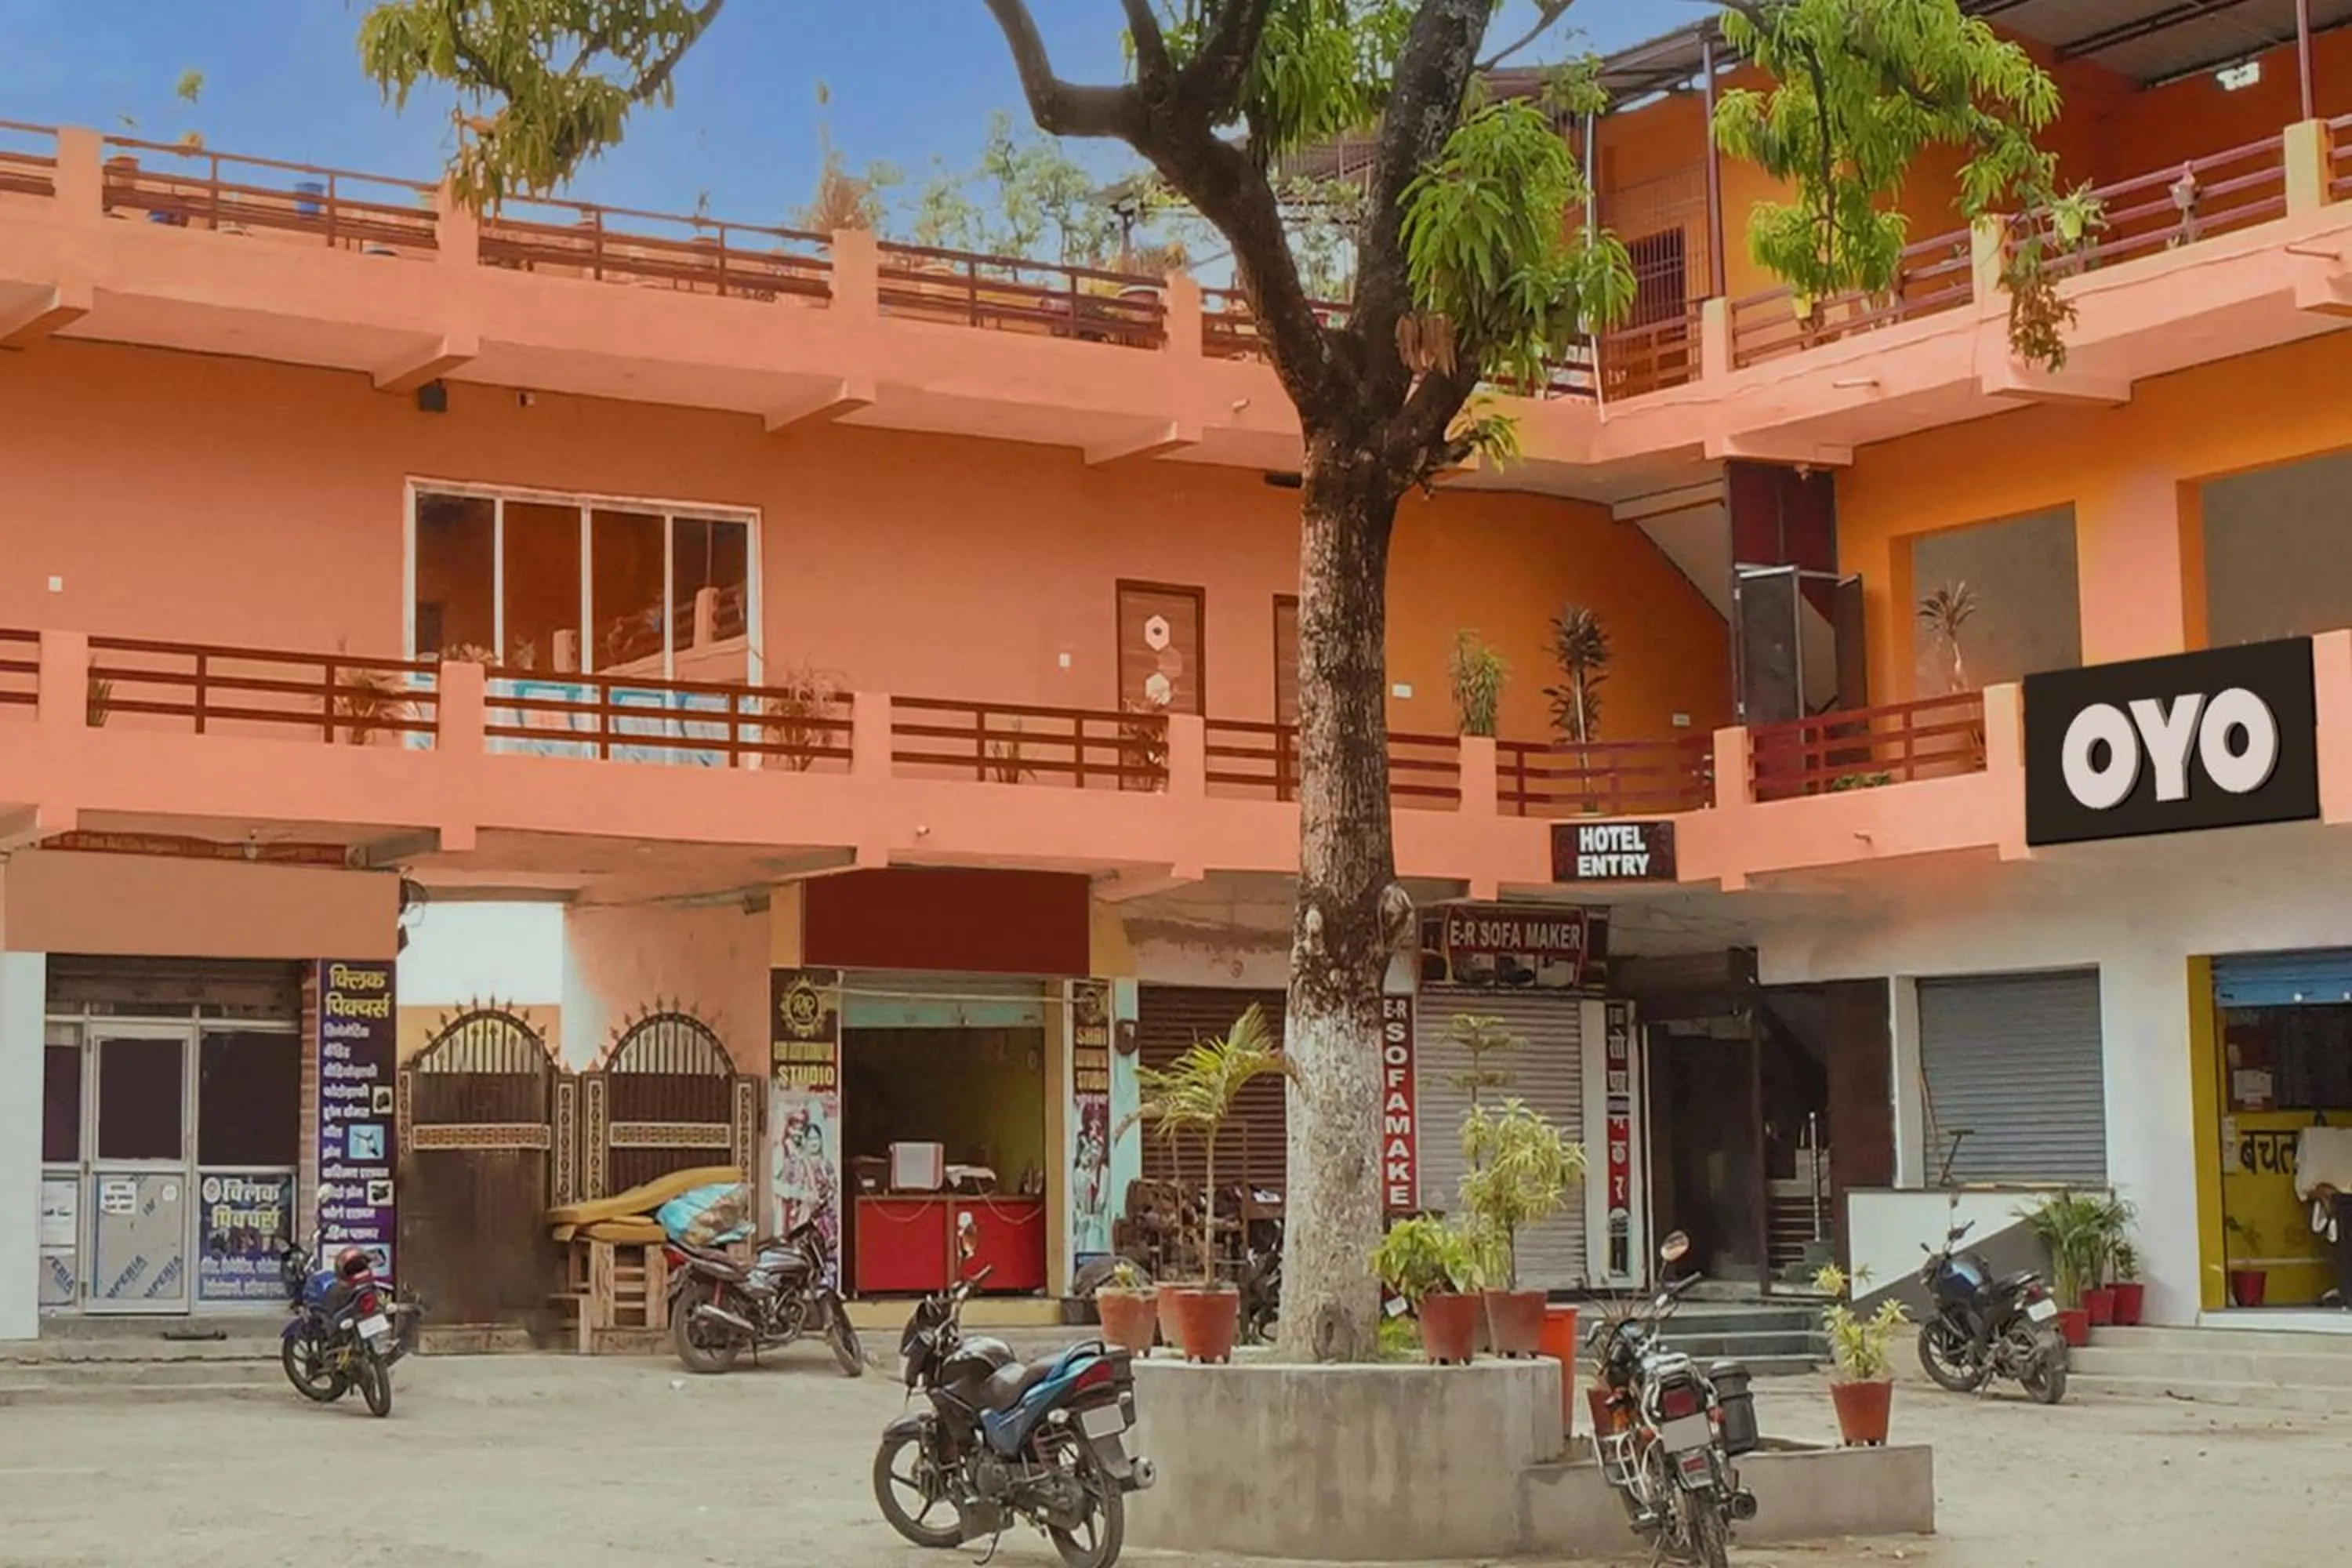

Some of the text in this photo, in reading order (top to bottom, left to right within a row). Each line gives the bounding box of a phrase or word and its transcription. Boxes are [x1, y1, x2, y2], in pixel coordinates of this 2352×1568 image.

[2061, 687, 2279, 810] OYO
[1579, 826, 1646, 852] HOTEL
[1577, 854, 1650, 877] ENTRY
[1450, 920, 1581, 949] E-R SOFA MAKER
[778, 1065, 835, 1086] STUDIO
